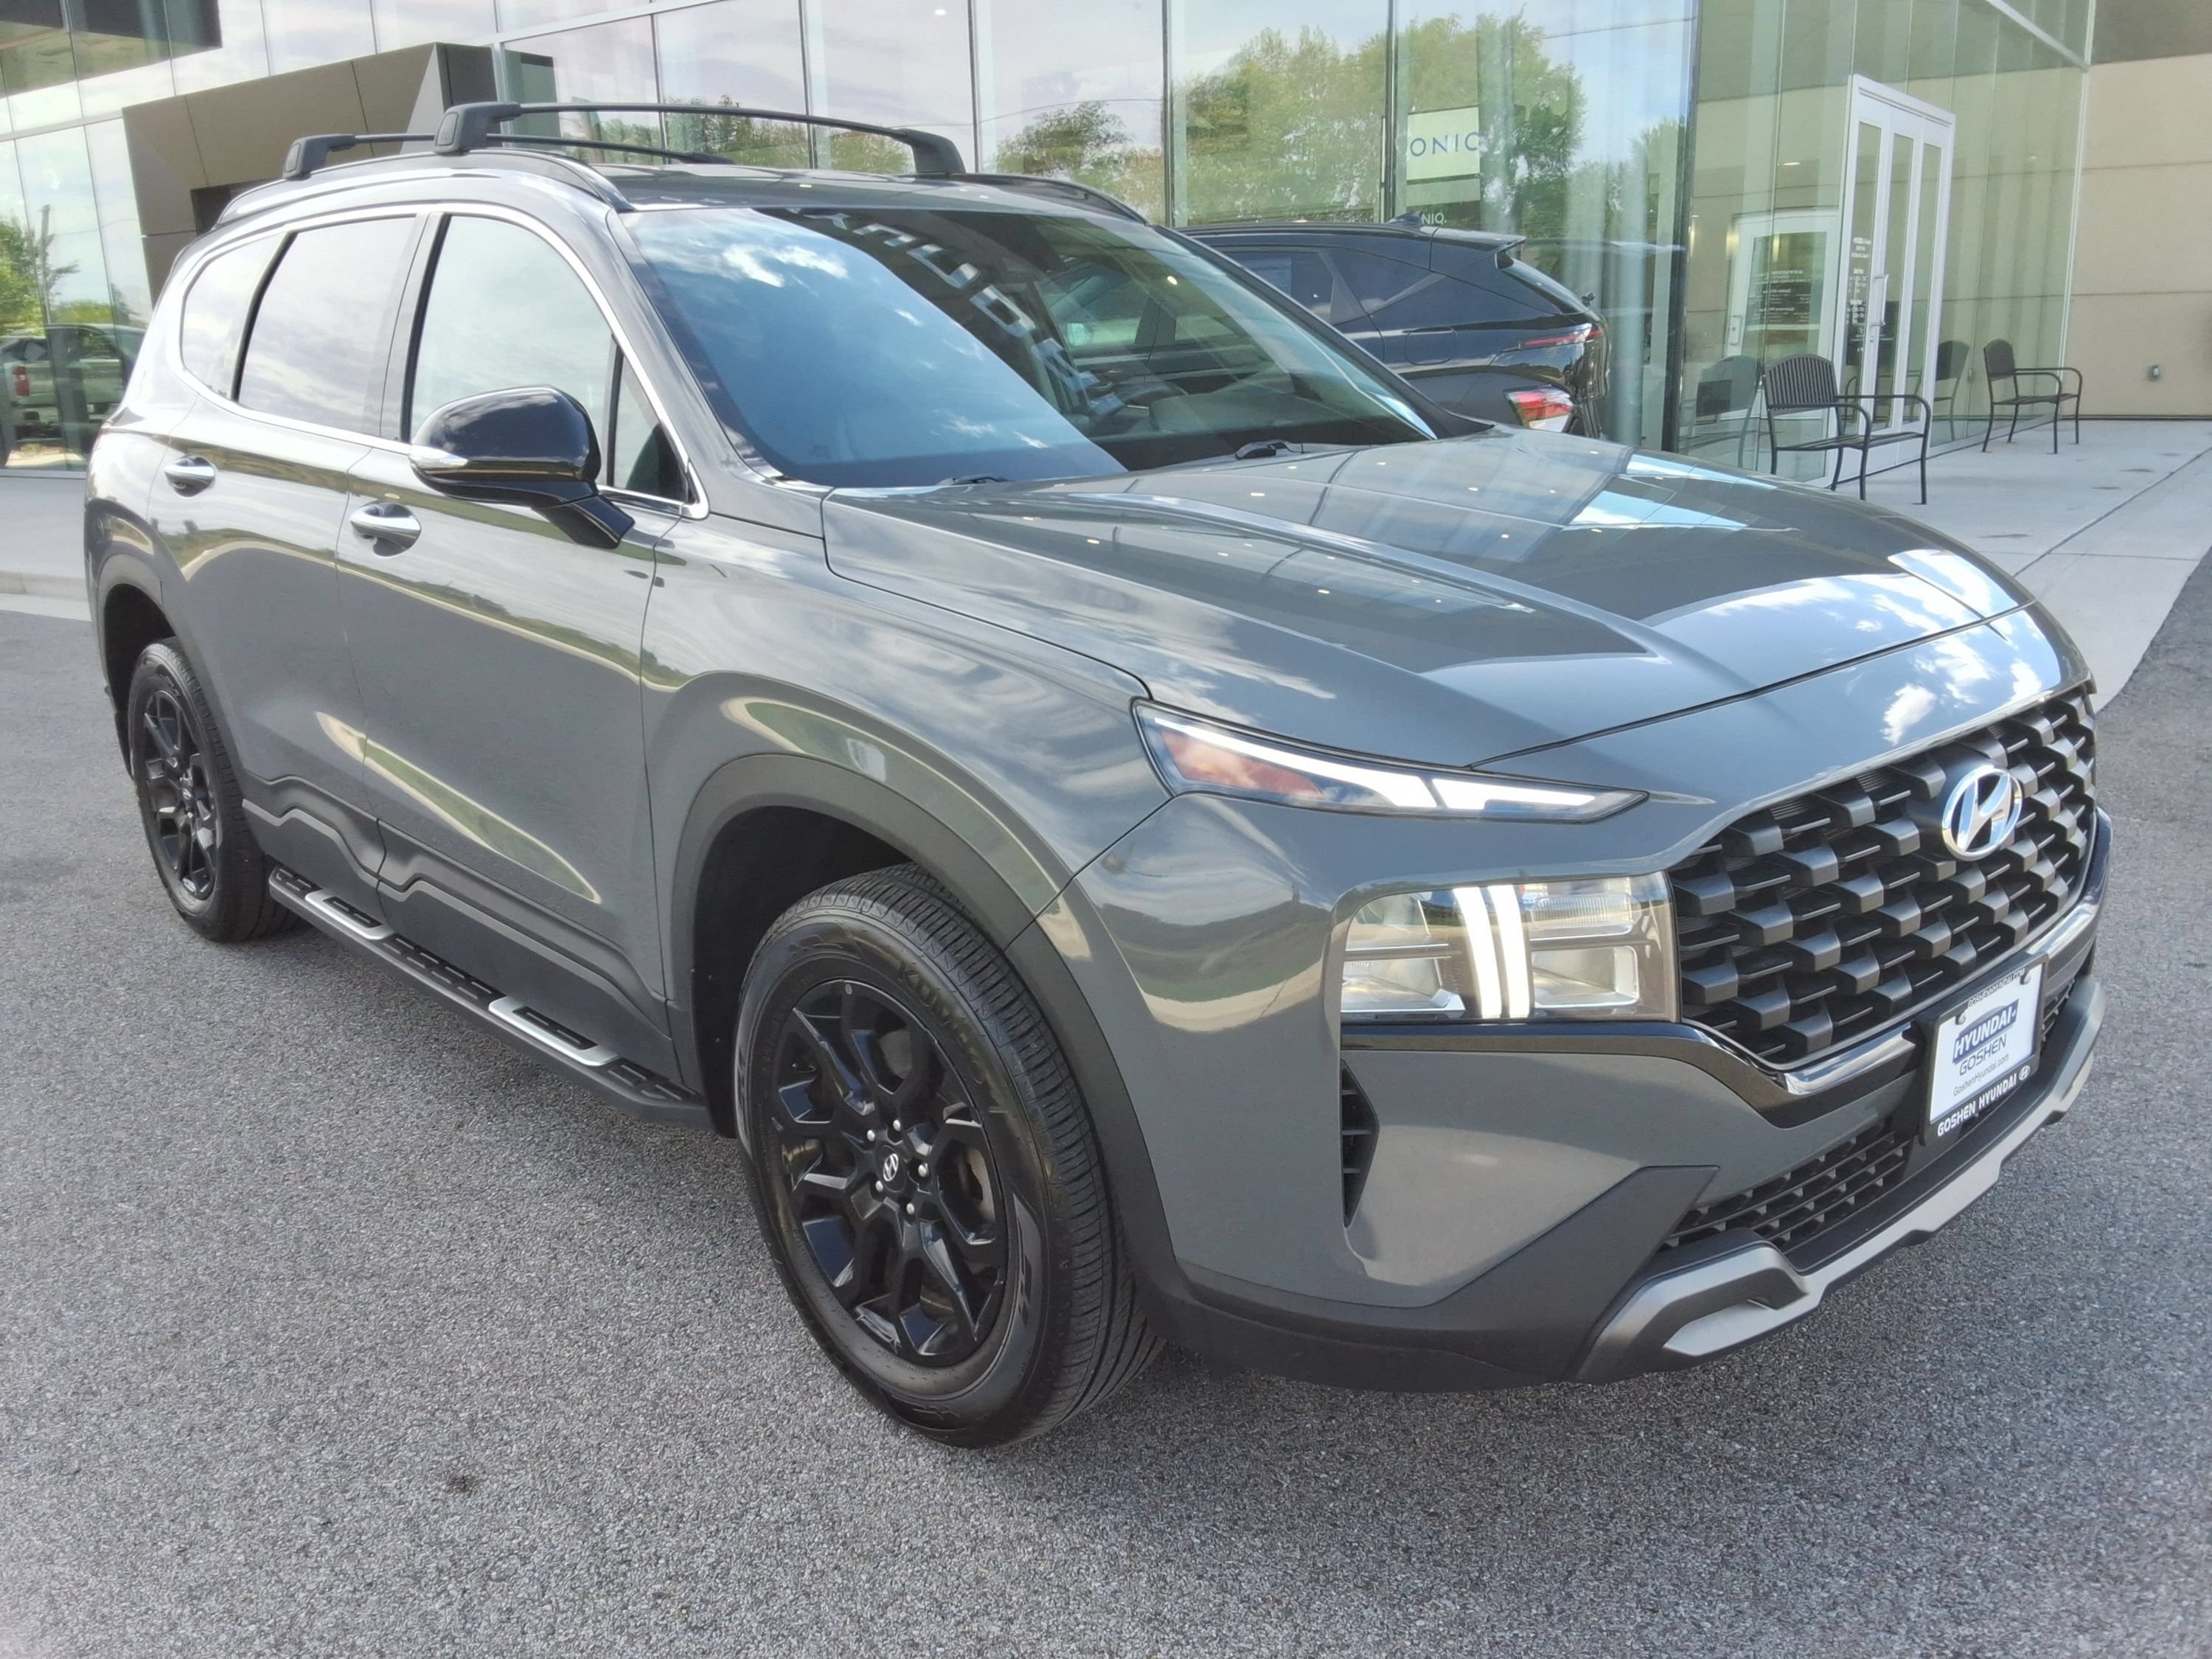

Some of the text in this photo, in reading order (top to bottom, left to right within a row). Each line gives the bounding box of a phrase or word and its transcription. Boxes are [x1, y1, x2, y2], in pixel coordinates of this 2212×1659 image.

[1955, 1010, 2012, 1059] HYUNDAI
[1959, 1034, 2007, 1076] GOSHEN
[1937, 1074, 2017, 1137] GOSHEN HYUNDAI
